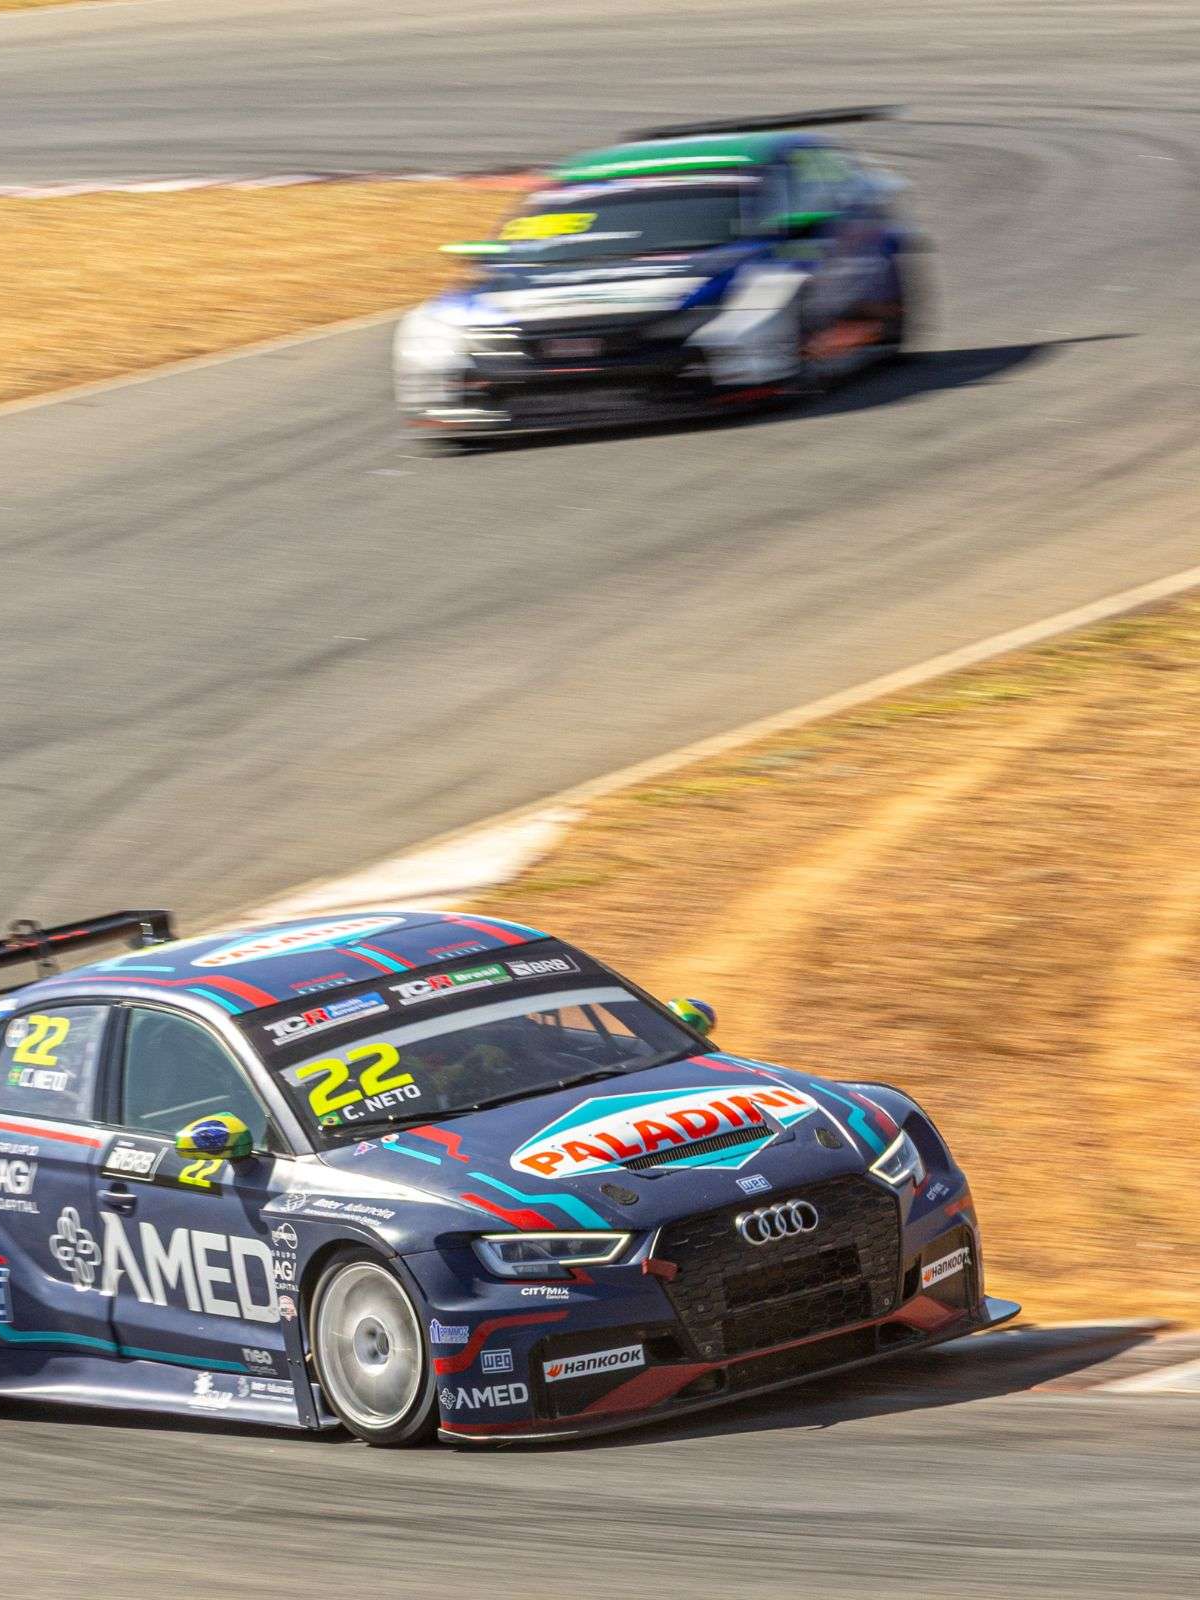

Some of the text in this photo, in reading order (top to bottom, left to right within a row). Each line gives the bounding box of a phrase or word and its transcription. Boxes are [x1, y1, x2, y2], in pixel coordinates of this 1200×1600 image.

[13, 1014, 71, 1066] 22
[263, 1007, 333, 1038] TCR
[295, 1042, 416, 1117] 22
[342, 1084, 422, 1120] C. NETO
[519, 1090, 808, 1176] PALADINI
[178, 1159, 225, 1188] 22
[99, 1211, 282, 1324] AMED
[455, 1382, 530, 1410] AMED
